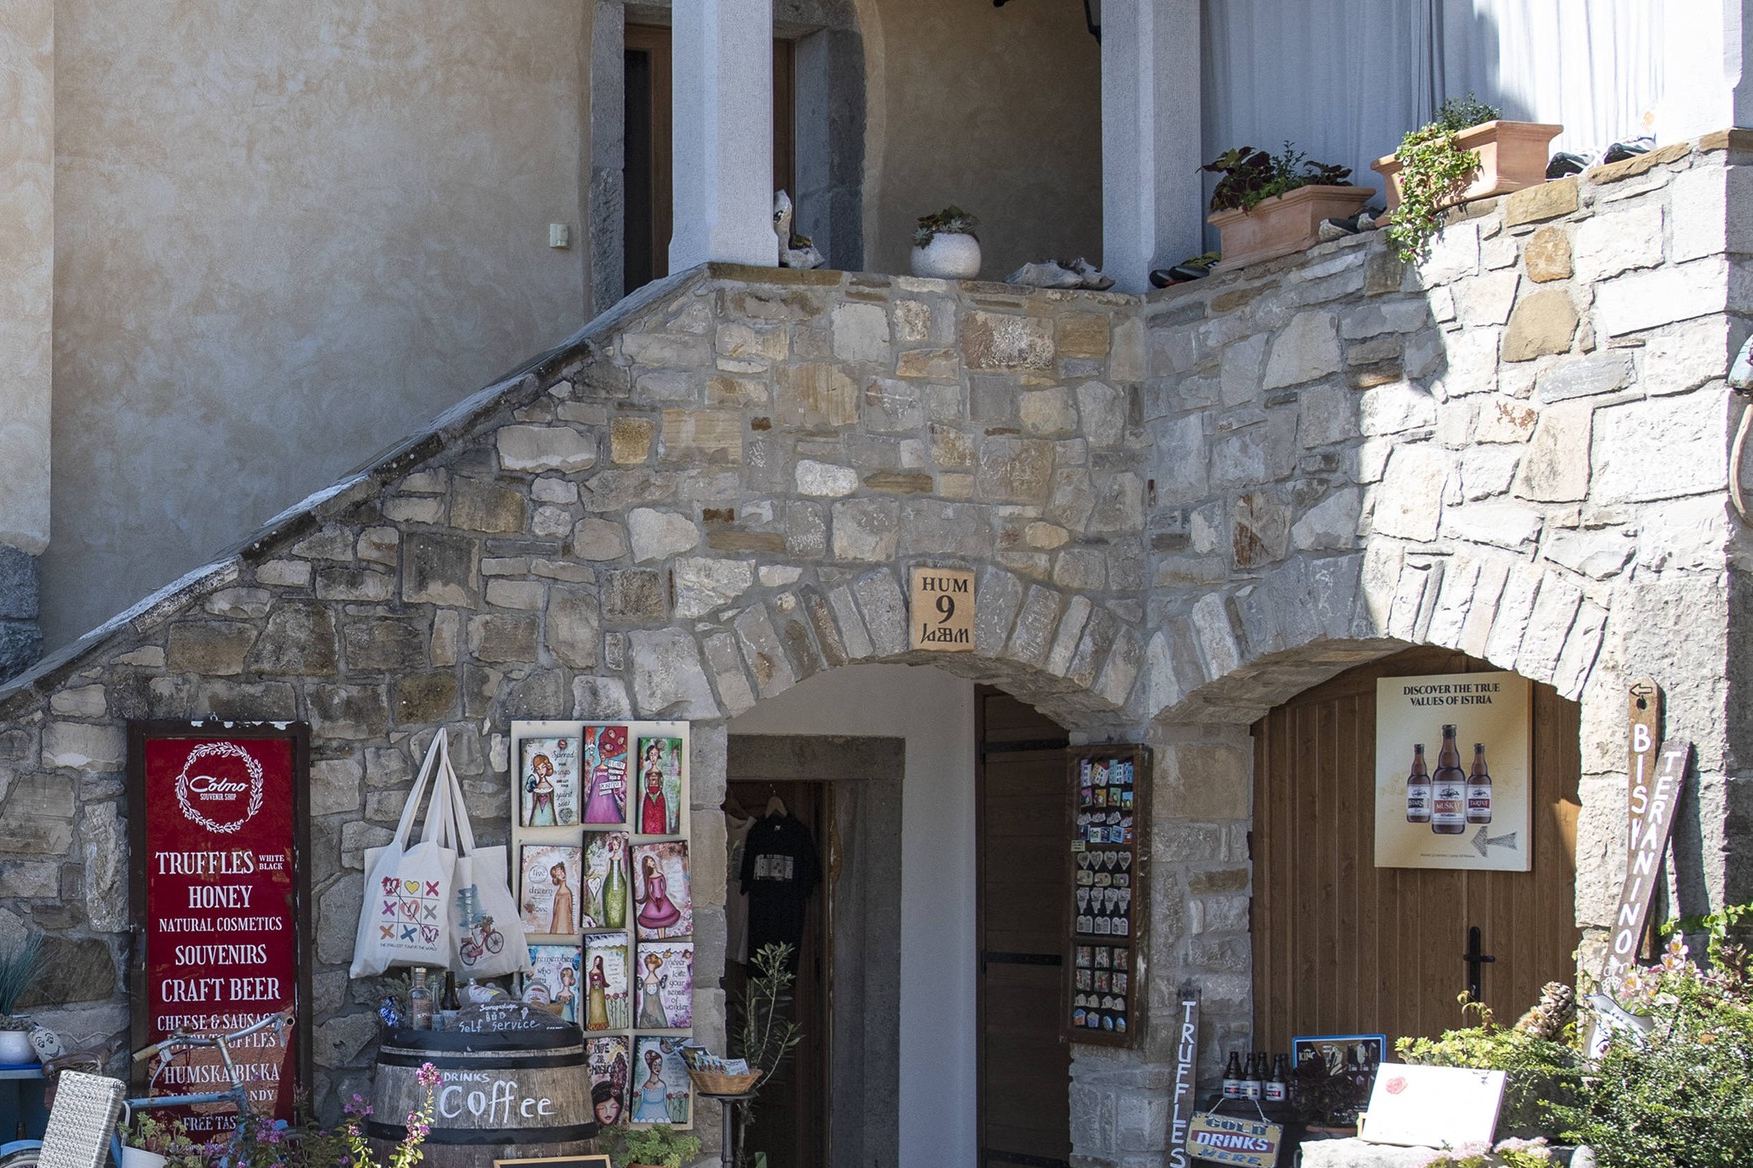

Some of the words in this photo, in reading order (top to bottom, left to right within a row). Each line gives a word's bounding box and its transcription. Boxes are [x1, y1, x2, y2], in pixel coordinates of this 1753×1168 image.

[921, 576, 969, 593] HUM
[935, 594, 955, 625] 9
[1403, 684, 1451, 696] DISCOVER
[1453, 683, 1472, 694] THE
[1474, 682, 1500, 693] TRUE
[1410, 696, 1444, 707] VALUES
[1446, 695, 1459, 706] OF
[1461, 695, 1493, 705] ISTRIA
[189, 775, 249, 793] Colmo
[199, 793, 224, 801] SOUVENIR
[224, 793, 237, 801] SHOP
[258, 854, 285, 862] WHITE
[1614, 751, 1682, 955] TERANINO
[155, 850, 255, 875] TRUFFLES
[258, 862, 284, 870] BLACK
[188, 884, 253, 909] HONEY
[159, 918, 215, 933] NATURAL
[216, 916, 283, 932] COSMETICS
[175, 943, 267, 966] SOUVENIRS
[161, 978, 225, 1002] CRAFT
[230, 977, 281, 1001] BEER
[210, 1013, 220, 1030] &
[164, 1064, 230, 1084] HUMSKA
[235, 1063, 280, 1082] BISKA
[443, 1072, 490, 1083] DRINKS
[1170, 1000, 1196, 1168] TRUFFLES
[439, 1080, 556, 1124] Coffee
[183, 1116, 214, 1131] FREE
[1205, 1116, 1267, 1136] COLD
[1196, 1131, 1270, 1151] DRINKS
[1200, 1147, 1261, 1165] HERE
